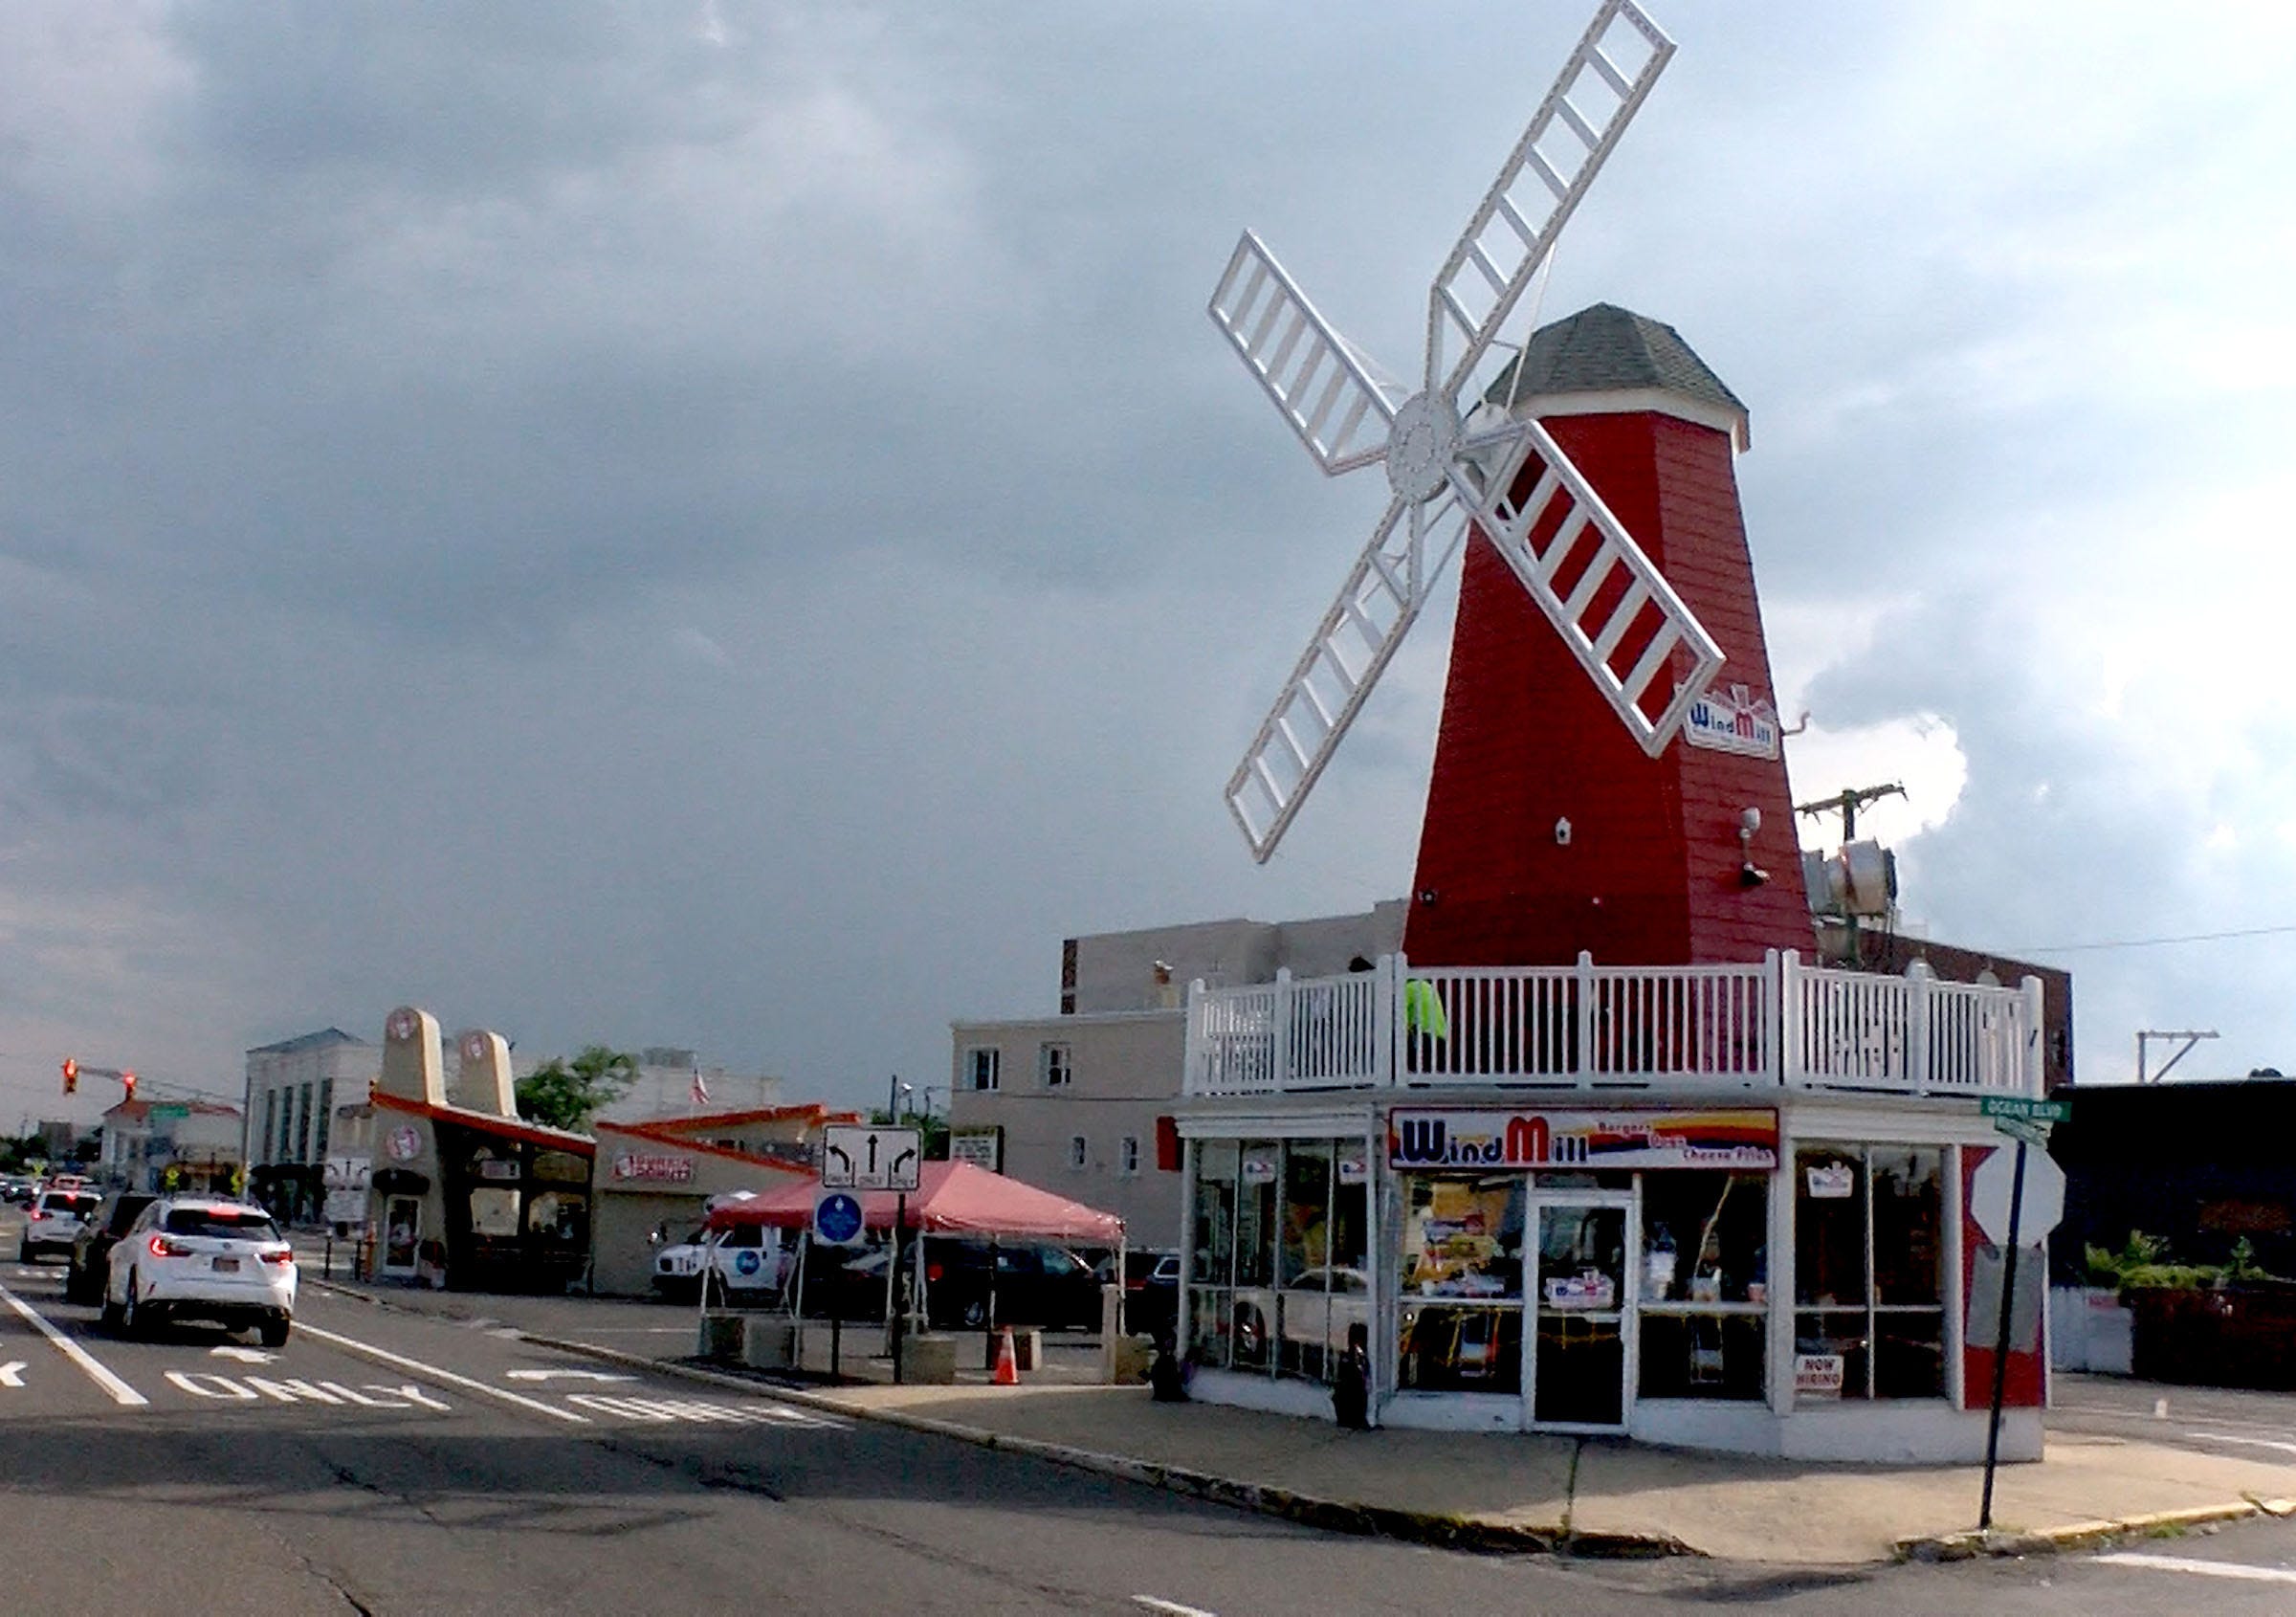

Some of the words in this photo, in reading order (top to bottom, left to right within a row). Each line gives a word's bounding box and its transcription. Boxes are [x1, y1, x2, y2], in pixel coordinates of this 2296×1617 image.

[1690, 702, 1771, 742] WindMill
[1804, 1358, 1836, 1371] NOW
[163, 1370, 453, 1410] ONLY
[1797, 1372, 1841, 1386] HIRING
